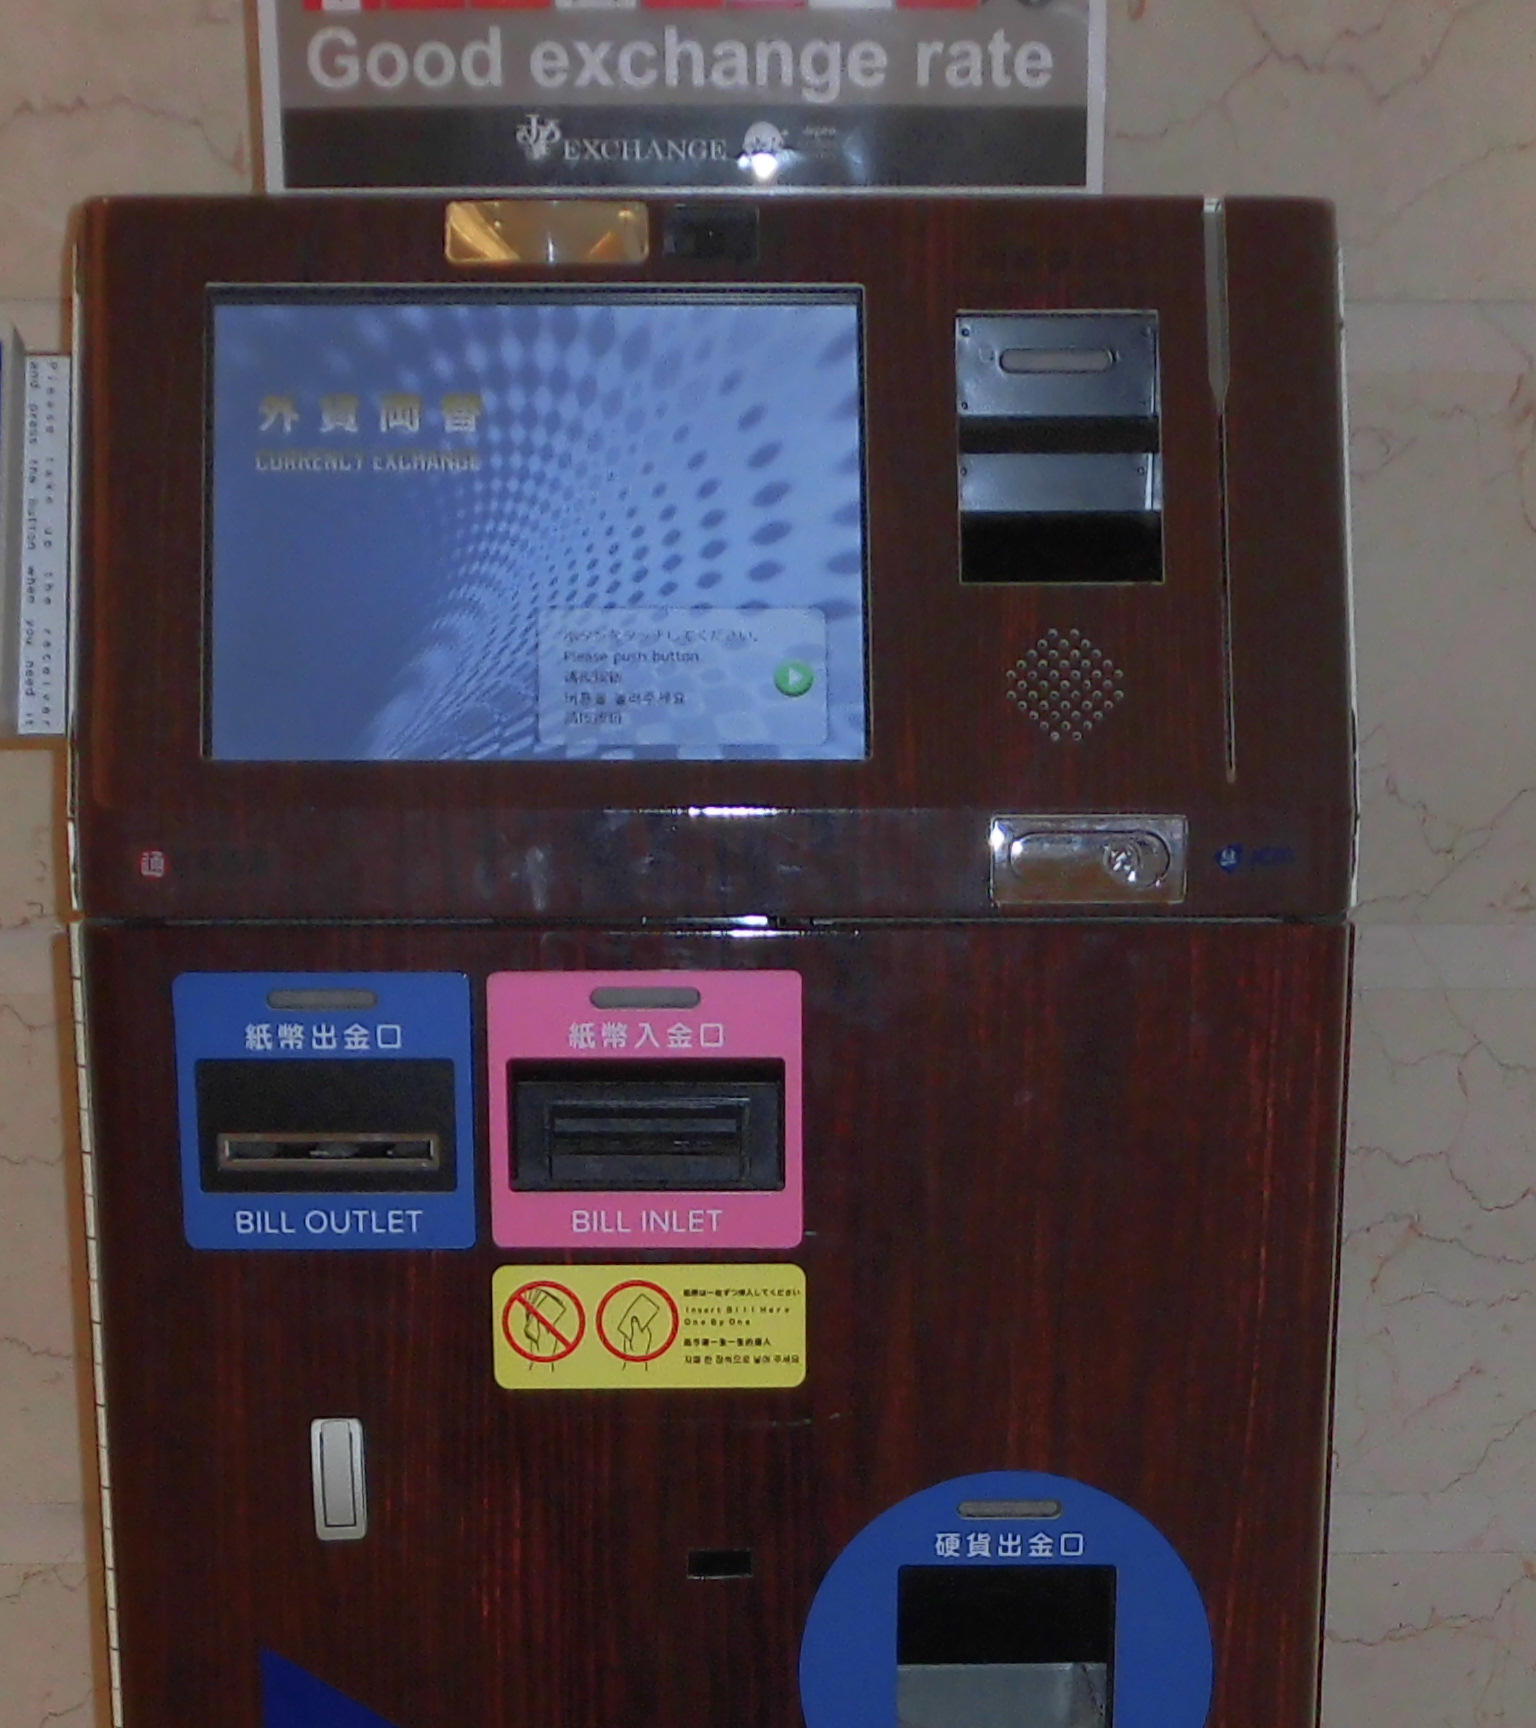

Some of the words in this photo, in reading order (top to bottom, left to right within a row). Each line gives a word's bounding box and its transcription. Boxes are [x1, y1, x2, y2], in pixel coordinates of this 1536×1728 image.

[306, 26, 504, 90] Good
[530, 25, 888, 103] exchange
[915, 29, 1053, 90] rate
[564, 138, 727, 162] EXCHANGE
[564, 650, 608, 662] Please
[614, 650, 647, 664] push
[652, 650, 700, 662] button
[244, 1022, 403, 1052] 紙幣出金口
[568, 1021, 726, 1051] 紙幣入金口
[235, 1210, 295, 1235] BILL
[304, 1210, 424, 1235] OUTLET
[571, 1210, 631, 1234] BILL
[640, 1210, 723, 1234] INLET
[685, 1306, 721, 1314] Insert
[726, 1306, 755, 1314] Bill
[760, 1306, 790, 1314] Here
[684, 1318, 706, 1326] One
[710, 1318, 724, 1327] By
[729, 1318, 751, 1326] One
[935, 1532, 1085, 1558] 硬貨出金口
